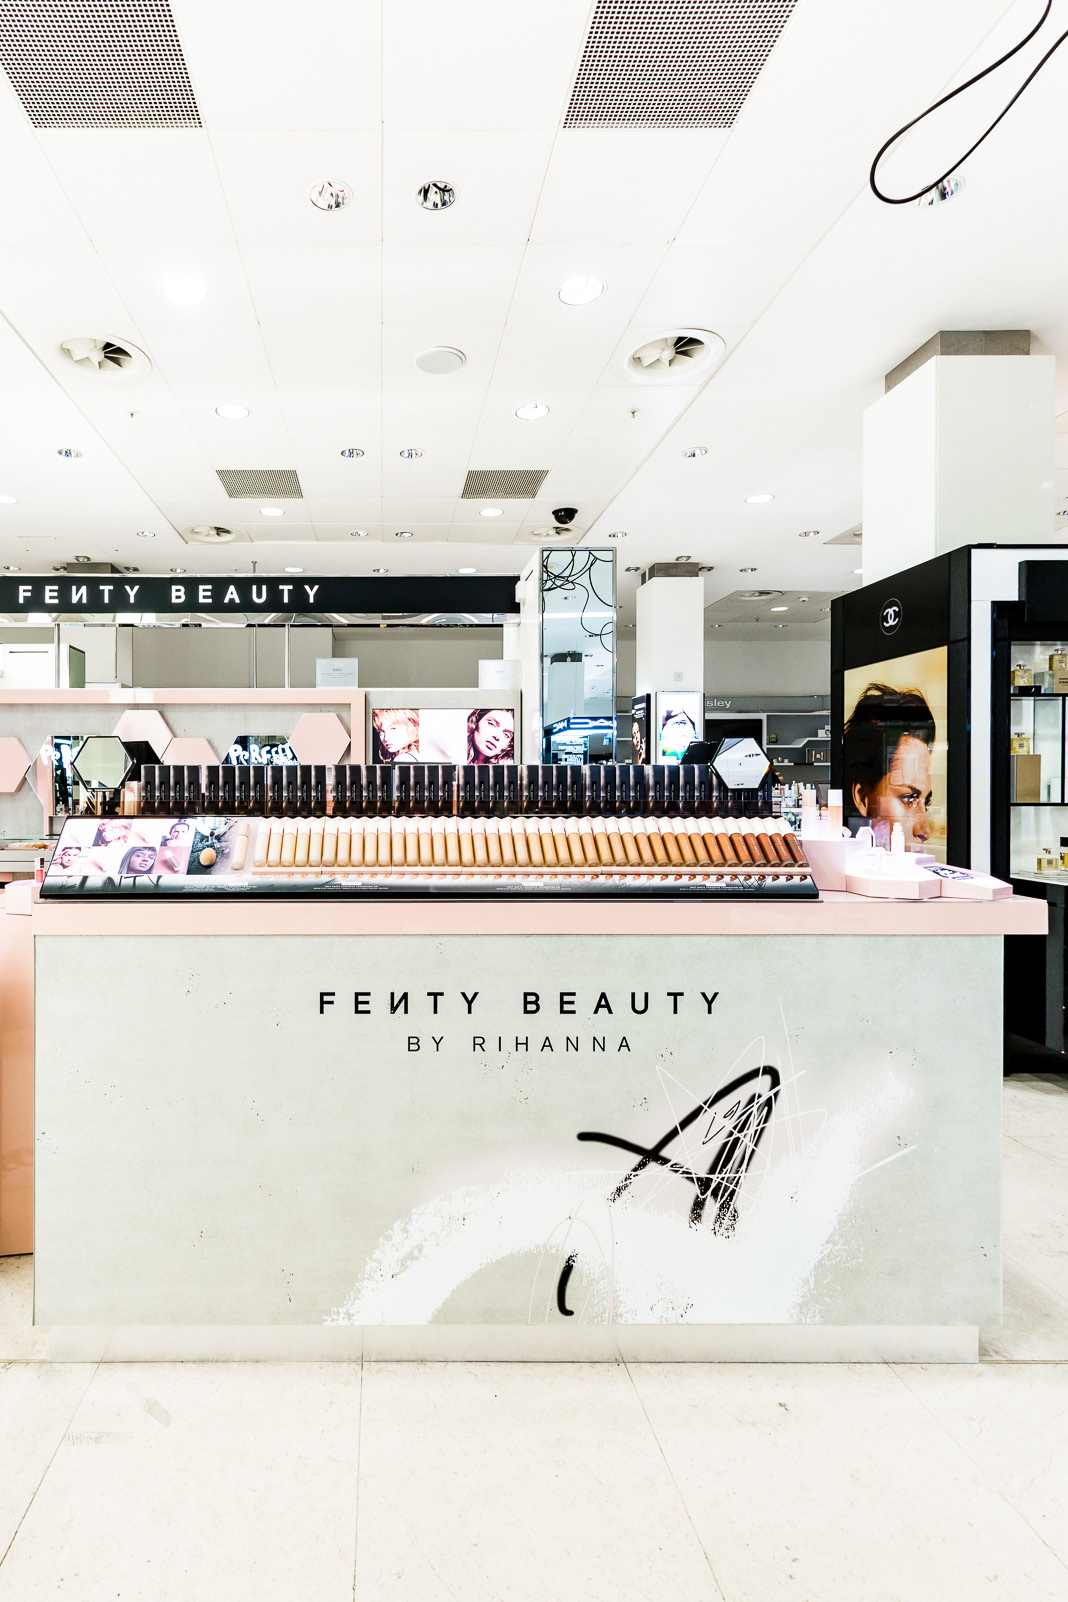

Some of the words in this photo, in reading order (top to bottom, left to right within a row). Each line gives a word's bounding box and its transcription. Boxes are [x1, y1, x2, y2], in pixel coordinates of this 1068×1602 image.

[171, 584, 320, 604] BEAUTY
[706, 699, 731, 709] sley
[523, 991, 720, 1015] BEAUTY
[407, 1036, 444, 1052] BY
[472, 1036, 631, 1052] RIHANNA
